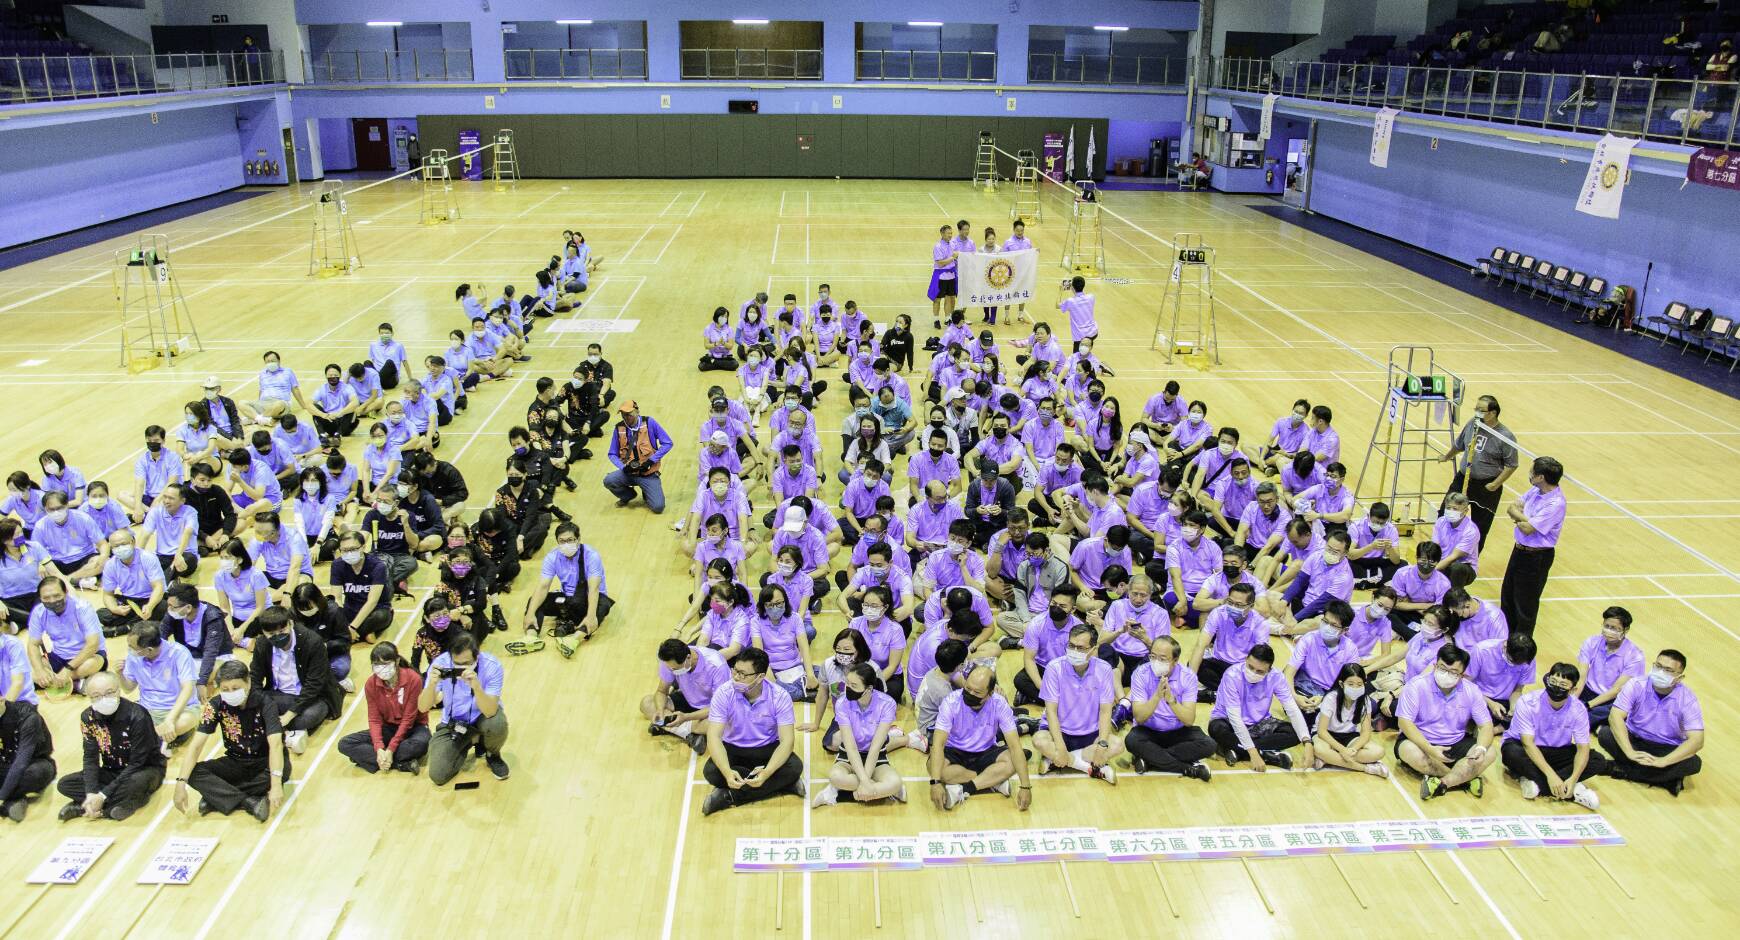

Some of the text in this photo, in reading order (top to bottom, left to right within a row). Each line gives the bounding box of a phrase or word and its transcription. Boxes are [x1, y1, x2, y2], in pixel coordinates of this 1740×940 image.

[1431, 137, 1437, 149] 2
[1705, 168, 1737, 184] 第七分區
[1410, 379, 1443, 392] 0 0
[1389, 397, 1398, 418] 5
[378, 529, 404, 540] TAIPEI
[1369, 828, 1447, 843] 第三分區
[1452, 824, 1528, 840] 第二分區
[1536, 822, 1612, 837] 第一分區
[1019, 836, 1098, 853] 第七分區
[1109, 837, 1188, 853] 第六分區
[1198, 834, 1276, 849] 第五分區
[1285, 830, 1361, 846] 第四分區
[742, 846, 822, 862] 第十分區
[836, 845, 914, 861] 第九分區
[928, 839, 1007, 855] 第八分區
